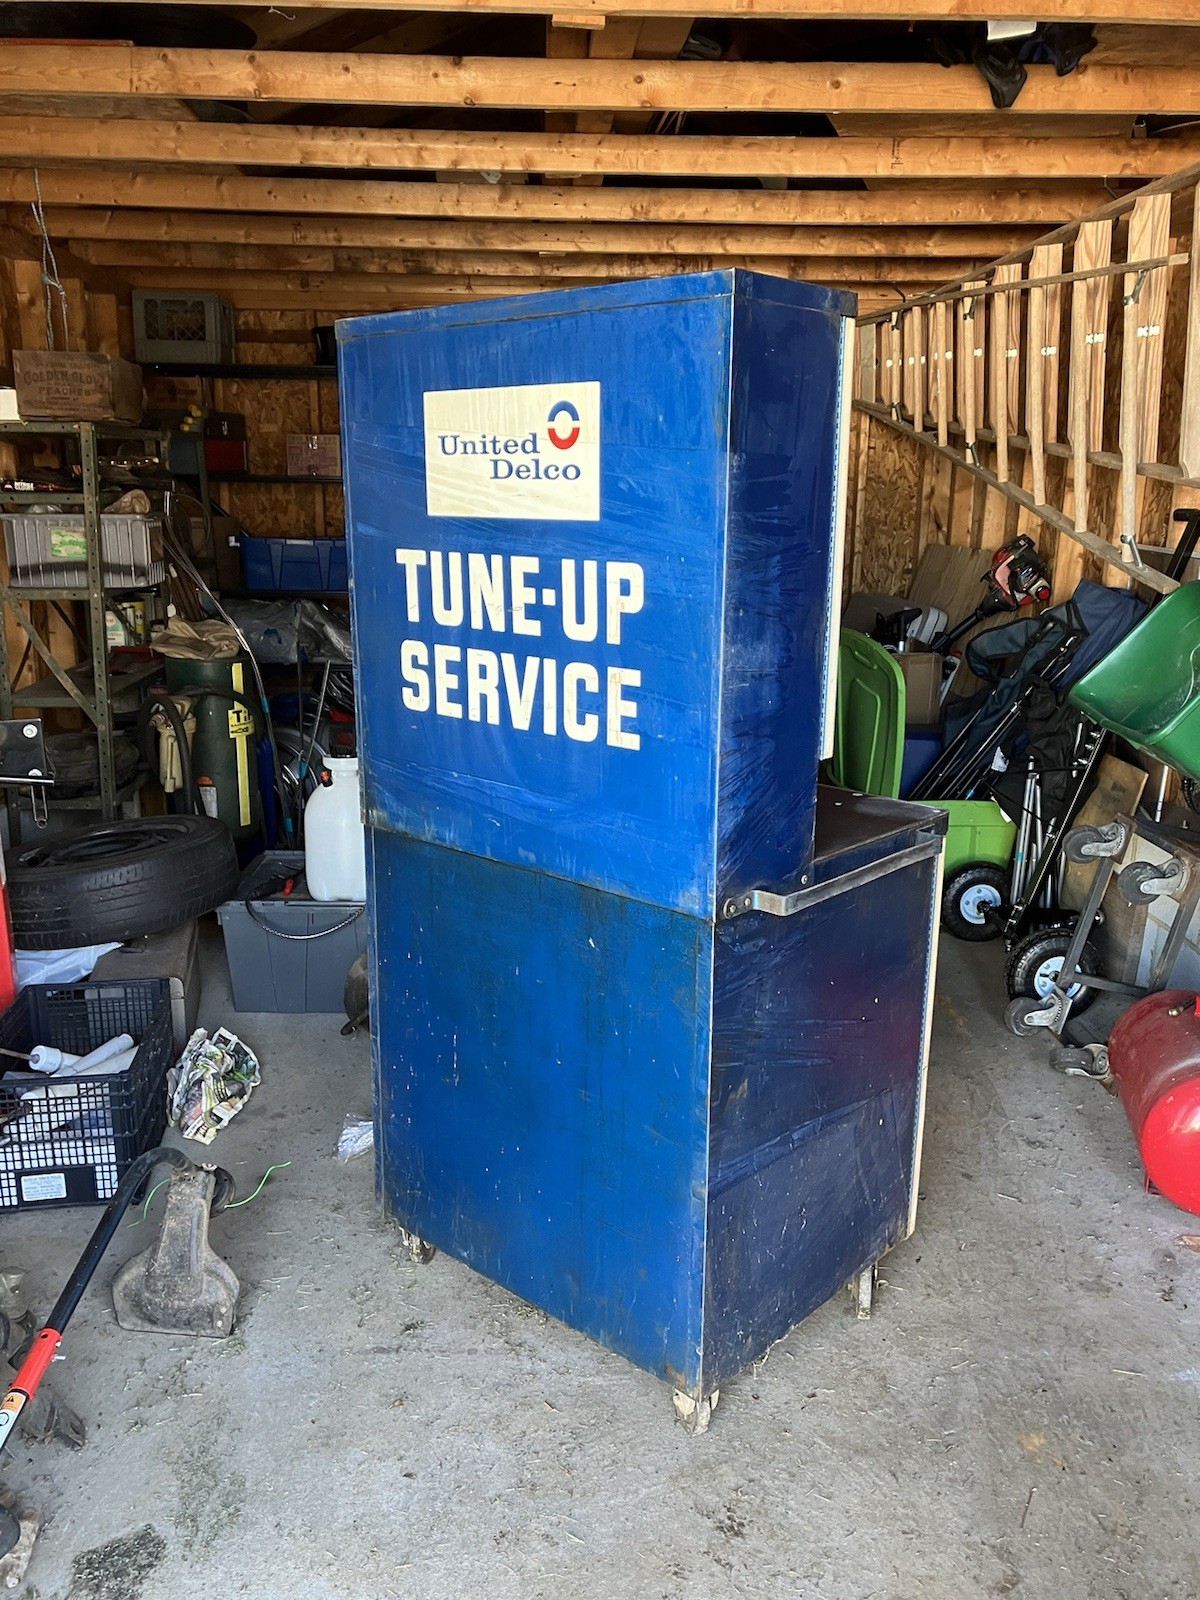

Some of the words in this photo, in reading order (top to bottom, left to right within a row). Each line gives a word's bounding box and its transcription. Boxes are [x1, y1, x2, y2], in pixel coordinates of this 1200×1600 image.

[23, 370, 69, 385] GOLDEN
[438, 433, 541, 456] United
[490, 457, 582, 480] Delco
[396, 549, 644, 645] TUNE-UP
[400, 640, 642, 750] SERVICE
